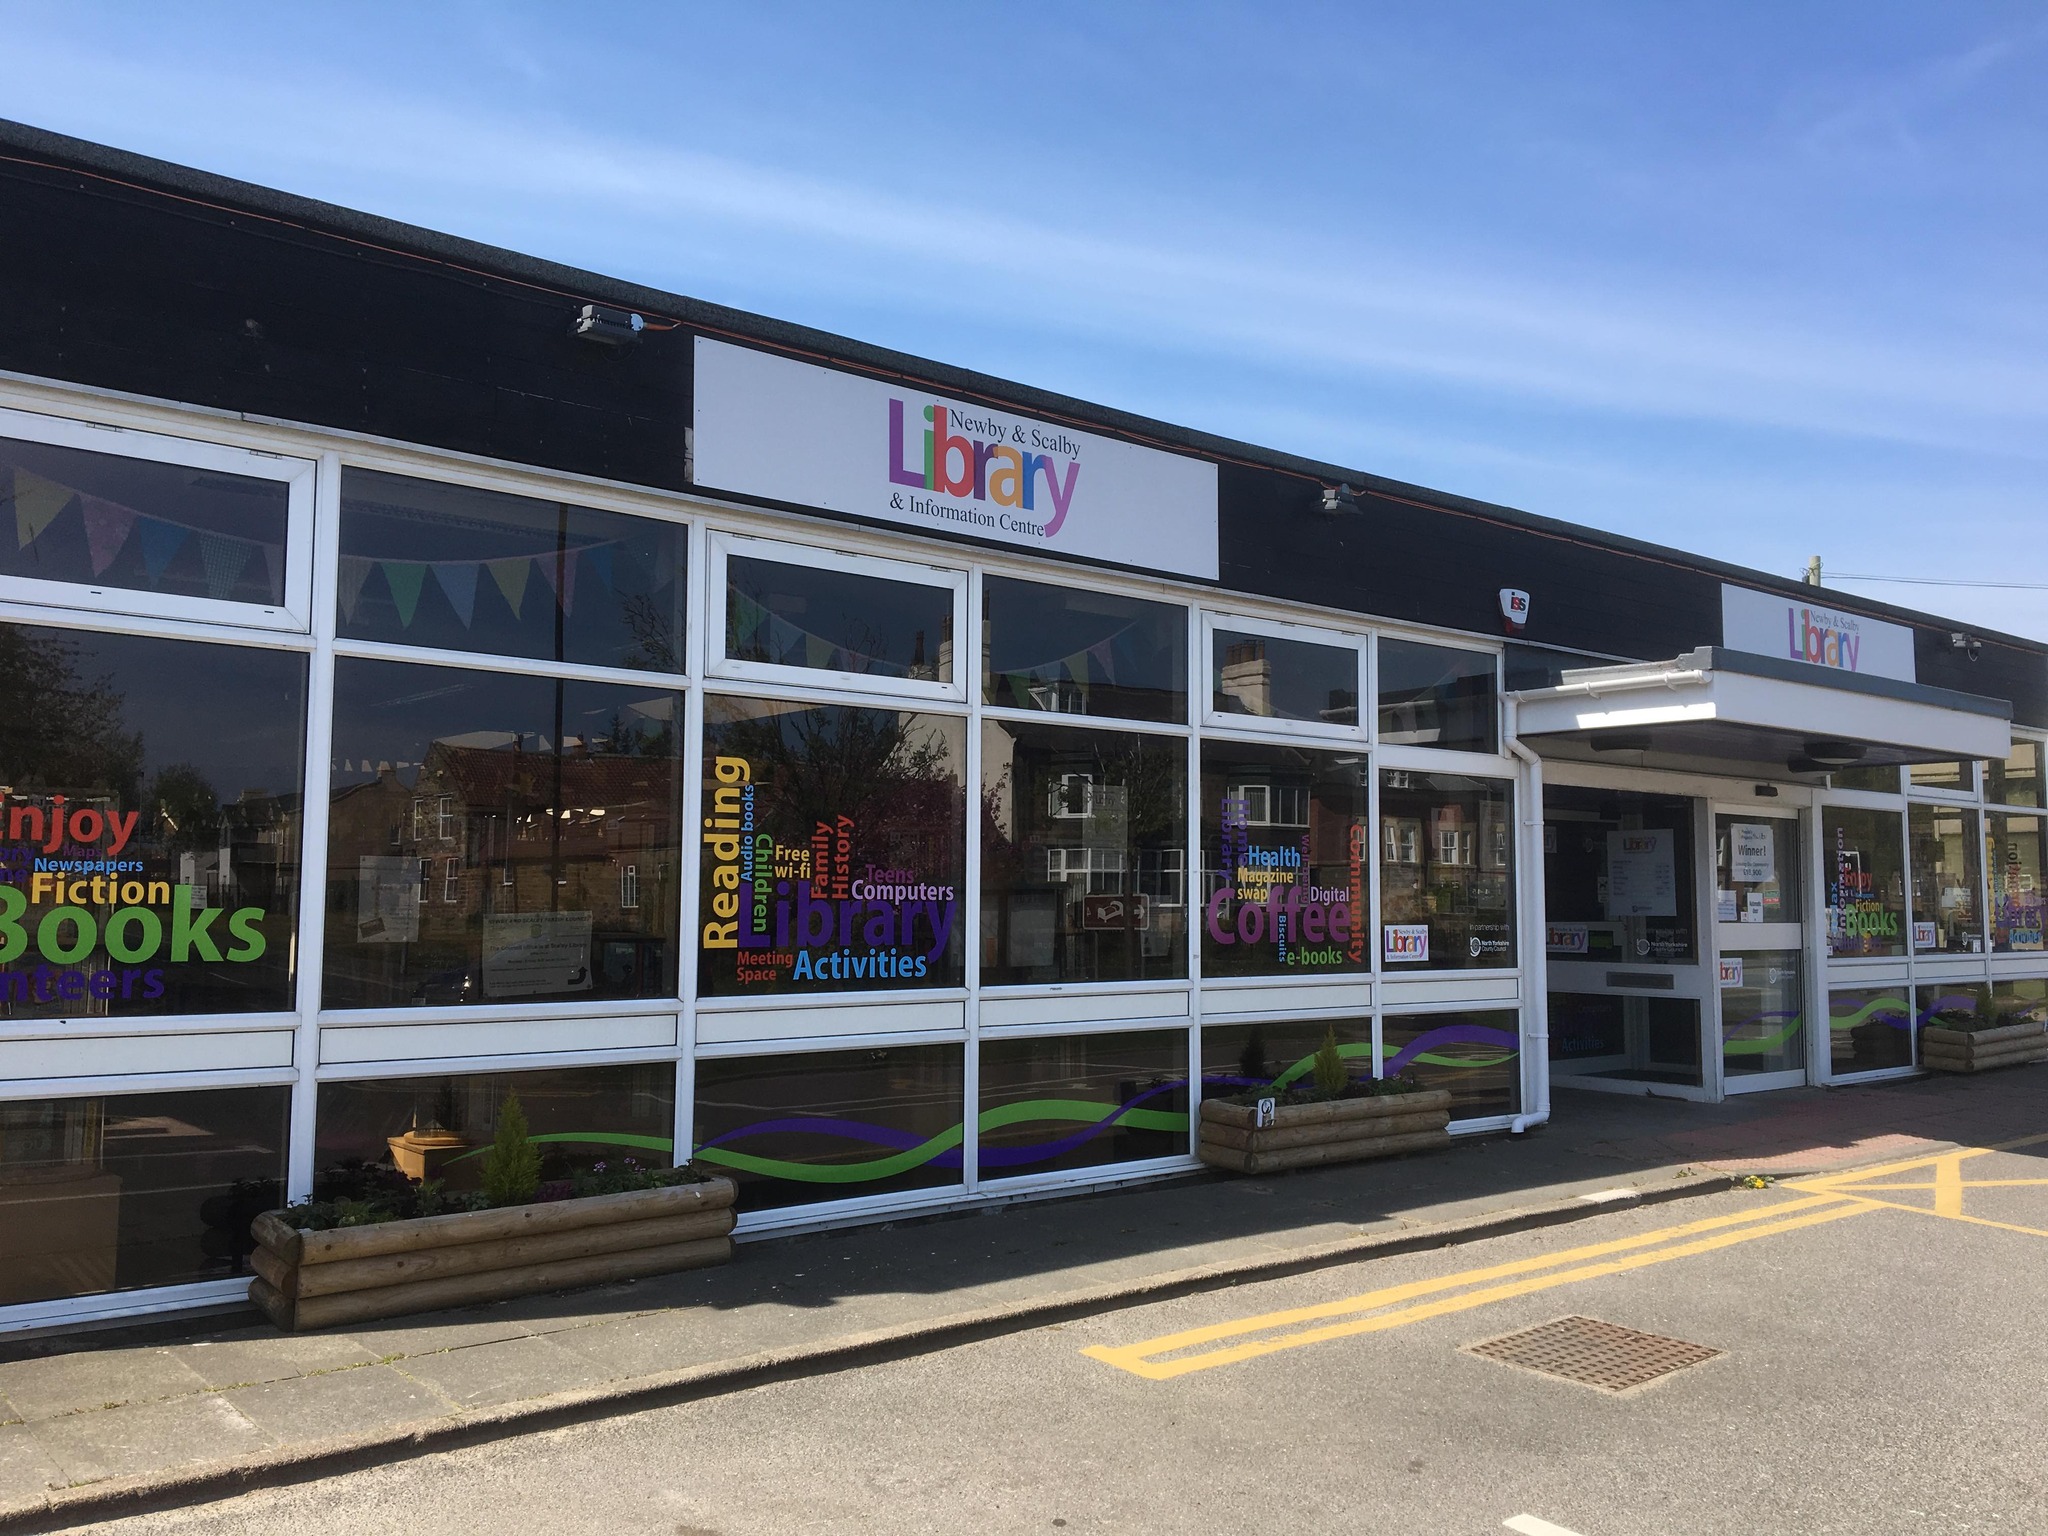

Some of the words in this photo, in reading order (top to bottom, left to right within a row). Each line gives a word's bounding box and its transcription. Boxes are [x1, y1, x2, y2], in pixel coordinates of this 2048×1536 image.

[950, 409, 1006, 442] Newby
[1012, 425, 1026, 443] &
[1031, 429, 1081, 459] Scalby
[889, 398, 1081, 538] Library
[890, 492, 904, 510] &
[909, 496, 995, 527] Information
[1000, 513, 1044, 536] Centre
[1810, 610, 1832, 628] Newby
[1840, 618, 1860, 634] Scalby
[1788, 608, 1860, 672] Library
[741, 784, 754, 831] books
[0, 791, 139, 857] njoy
[1218, 799, 1232, 881] Library
[1237, 799, 1250, 867] Home
[34, 858, 144, 875] Newspapers
[63, 844, 102, 859] Maps
[703, 756, 750, 948] Reading
[741, 836, 753, 881] Audio
[775, 845, 810, 862] Free
[811, 821, 834, 899] Family
[832, 814, 855, 900] History
[1248, 845, 1300, 867] Health
[1738, 845, 1766, 856] Winner!
[754, 833, 773, 932] Children
[775, 862, 810, 878] wi-fi
[865, 864, 914, 884] Teens
[1237, 867, 1294, 886] Magazine
[32, 873, 170, 905] Fiction
[851, 880, 954, 905] Computers
[1237, 888, 1268, 902] swap
[1311, 886, 1349, 906] Digital
[1208, 886, 1350, 945] Coffee
[1846, 904, 1897, 937] Books
[1856, 899, 1879, 912] Fiction
[739, 881, 957, 964] Library
[1278, 915, 1286, 962] Biscuits
[1287, 946, 1342, 965] e-books
[1386, 929, 1427, 958] Library
[737, 952, 793, 968] Meeting
[737, 967, 776, 984] Space
[793, 948, 927, 981] Activities
